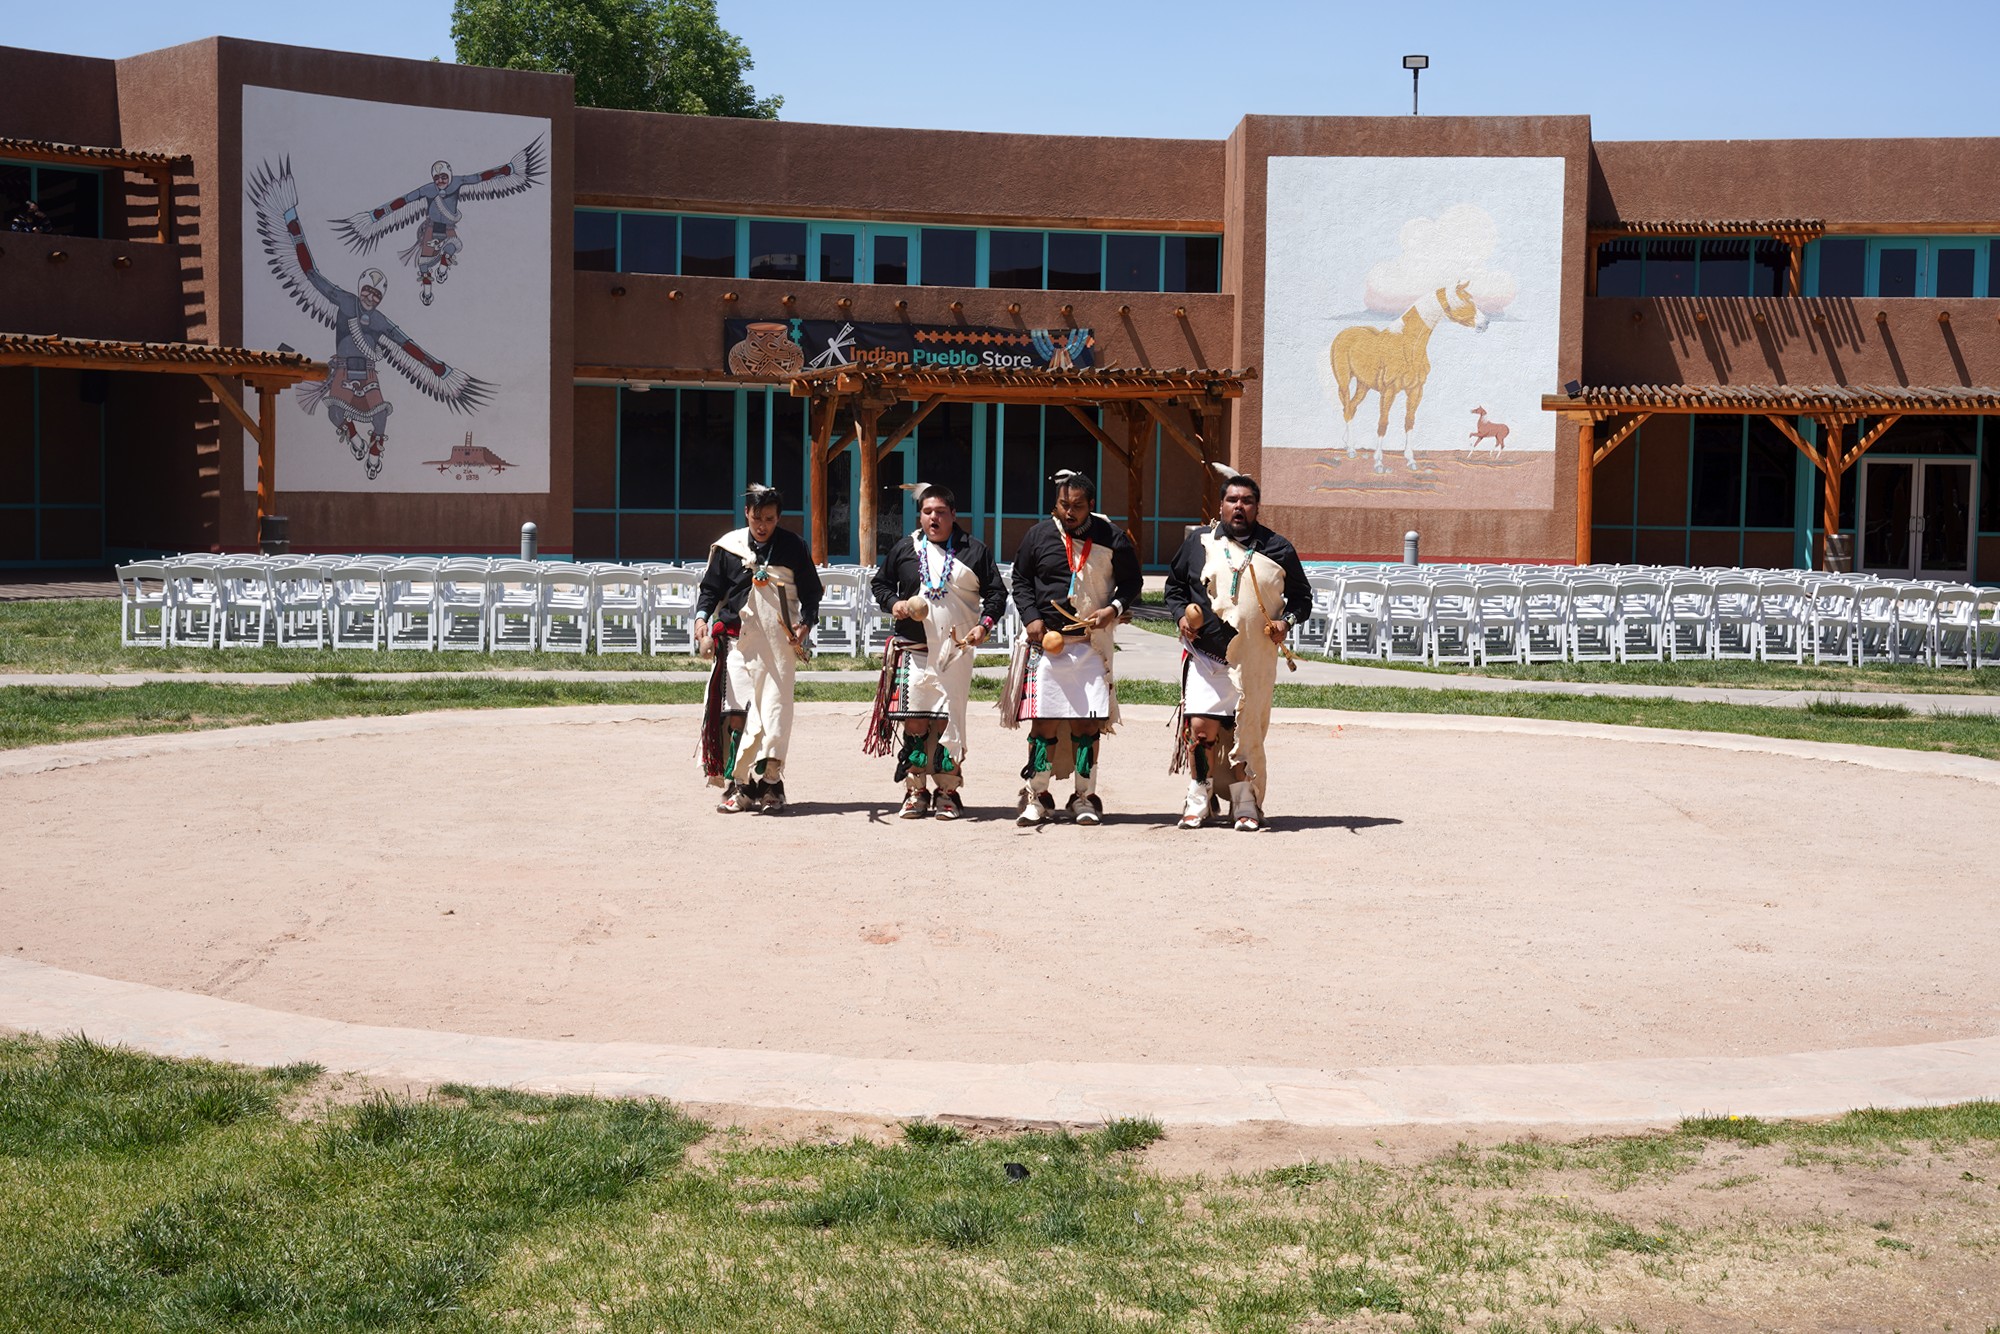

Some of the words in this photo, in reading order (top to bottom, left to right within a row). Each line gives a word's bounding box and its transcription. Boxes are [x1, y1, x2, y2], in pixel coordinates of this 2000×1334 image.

[850, 345, 909, 363] Indian
[913, 348, 979, 365] Pueblo
[982, 350, 1032, 367] Store
